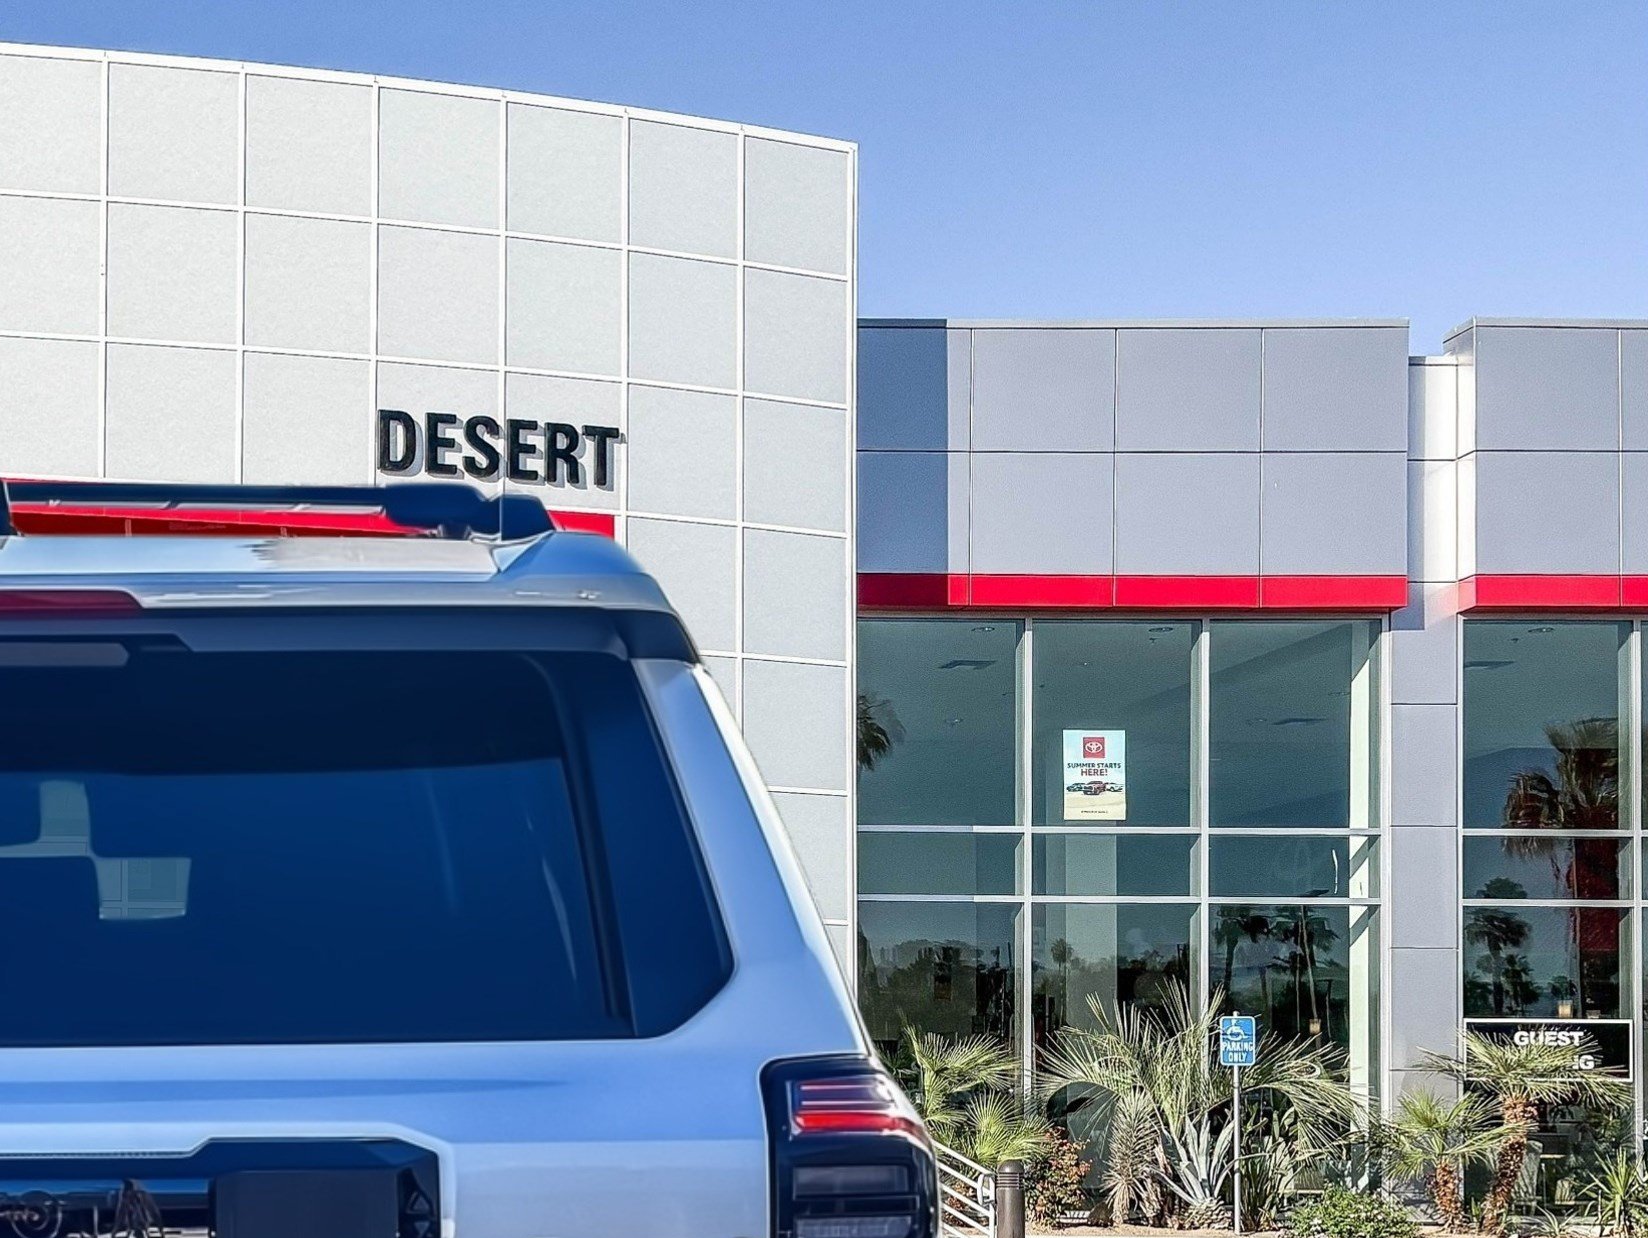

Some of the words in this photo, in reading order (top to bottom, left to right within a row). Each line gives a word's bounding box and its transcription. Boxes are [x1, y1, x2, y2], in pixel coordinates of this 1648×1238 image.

[377, 409, 620, 486] DESERT
[1080, 768, 1108, 776] HERE!
[1513, 1030, 1585, 1047] GUEST
[1222, 1041, 1254, 1051] PARKING
[1228, 1052, 1248, 1062] ONLY
